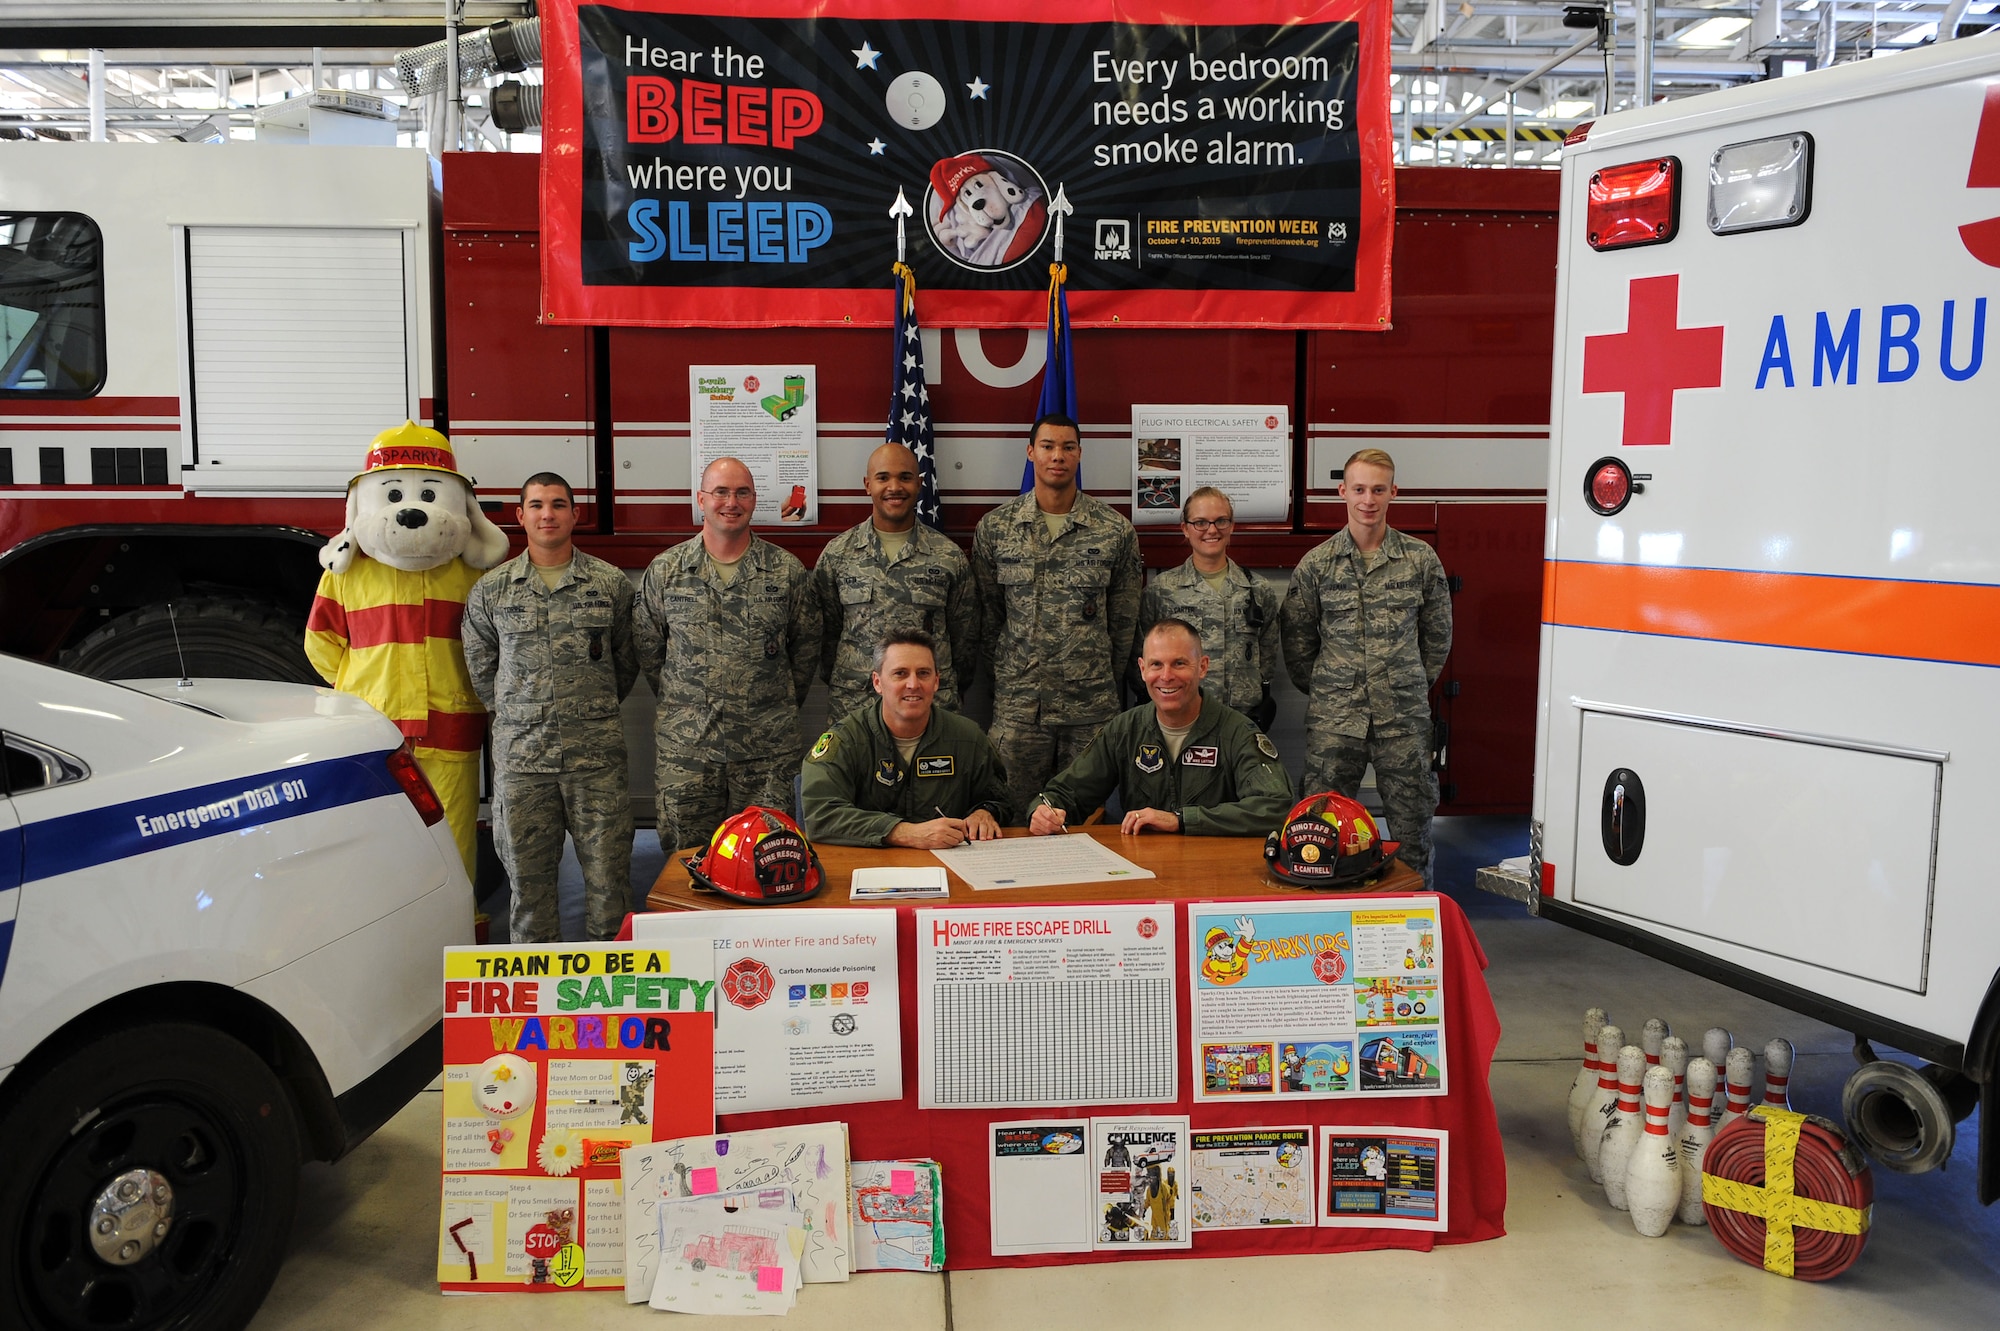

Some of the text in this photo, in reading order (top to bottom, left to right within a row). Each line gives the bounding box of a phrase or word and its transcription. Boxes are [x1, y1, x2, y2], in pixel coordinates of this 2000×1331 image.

[625, 35, 764, 78] Hear the
[1093, 50, 1328, 90] Every bedroom
[626, 75, 824, 150] BEEP
[1093, 90, 1344, 130] needs a working
[1093, 132, 1304, 167] smoke alarm.
[627, 157, 792, 199] where you
[627, 199, 833, 263] SLEEP
[1147, 219, 1318, 234] FIRE PREVENTION WEEK
[1147, 237, 1221, 245] October 4-10, 2015
[1236, 237, 1318, 247] firepreventionweek.org
[1094, 250, 1131, 260] NFPA
[1754, 297, 1987, 389] AMBU
[698, 386, 735, 395] Battery
[382, 449, 438, 462] SPARKY
[135, 779, 308, 837] Emergency Dial 911
[1291, 823, 1329, 834] MINOT AFB
[762, 838, 798, 851] MINOT AFB
[1294, 834, 1326, 844] CAPTAIN
[760, 850, 801, 865] FIRE RESCUE
[768, 861, 798, 883] 70
[1299, 866, 1329, 874] CANTRELL
[776, 884, 794, 892] USAF
[933, 920, 1111, 946] HOME FIRE ESCAPE DRILL
[713, 939, 732, 950] EZE
[753, 936, 791, 948] Winter
[795, 936, 815, 947] Fire
[819, 935, 839, 946] and
[842, 934, 877, 946] Safety
[1251, 932, 1350, 963] SPARKY.ORG
[476, 952, 662, 978] TRAIN TO BE A
[806, 966, 840, 974] Monoxide
[842, 964, 876, 973] Poisoning
[444, 975, 716, 1014] FIRE SAFETY
[489, 1017, 671, 1051] WARRIOR
[1421, 1032, 1433, 1040] play
[1212, 1134, 1253, 1142] PREVENTION
[1282, 1132, 1303, 1140] ROUTE
[527, 1233, 560, 1249] STOP
